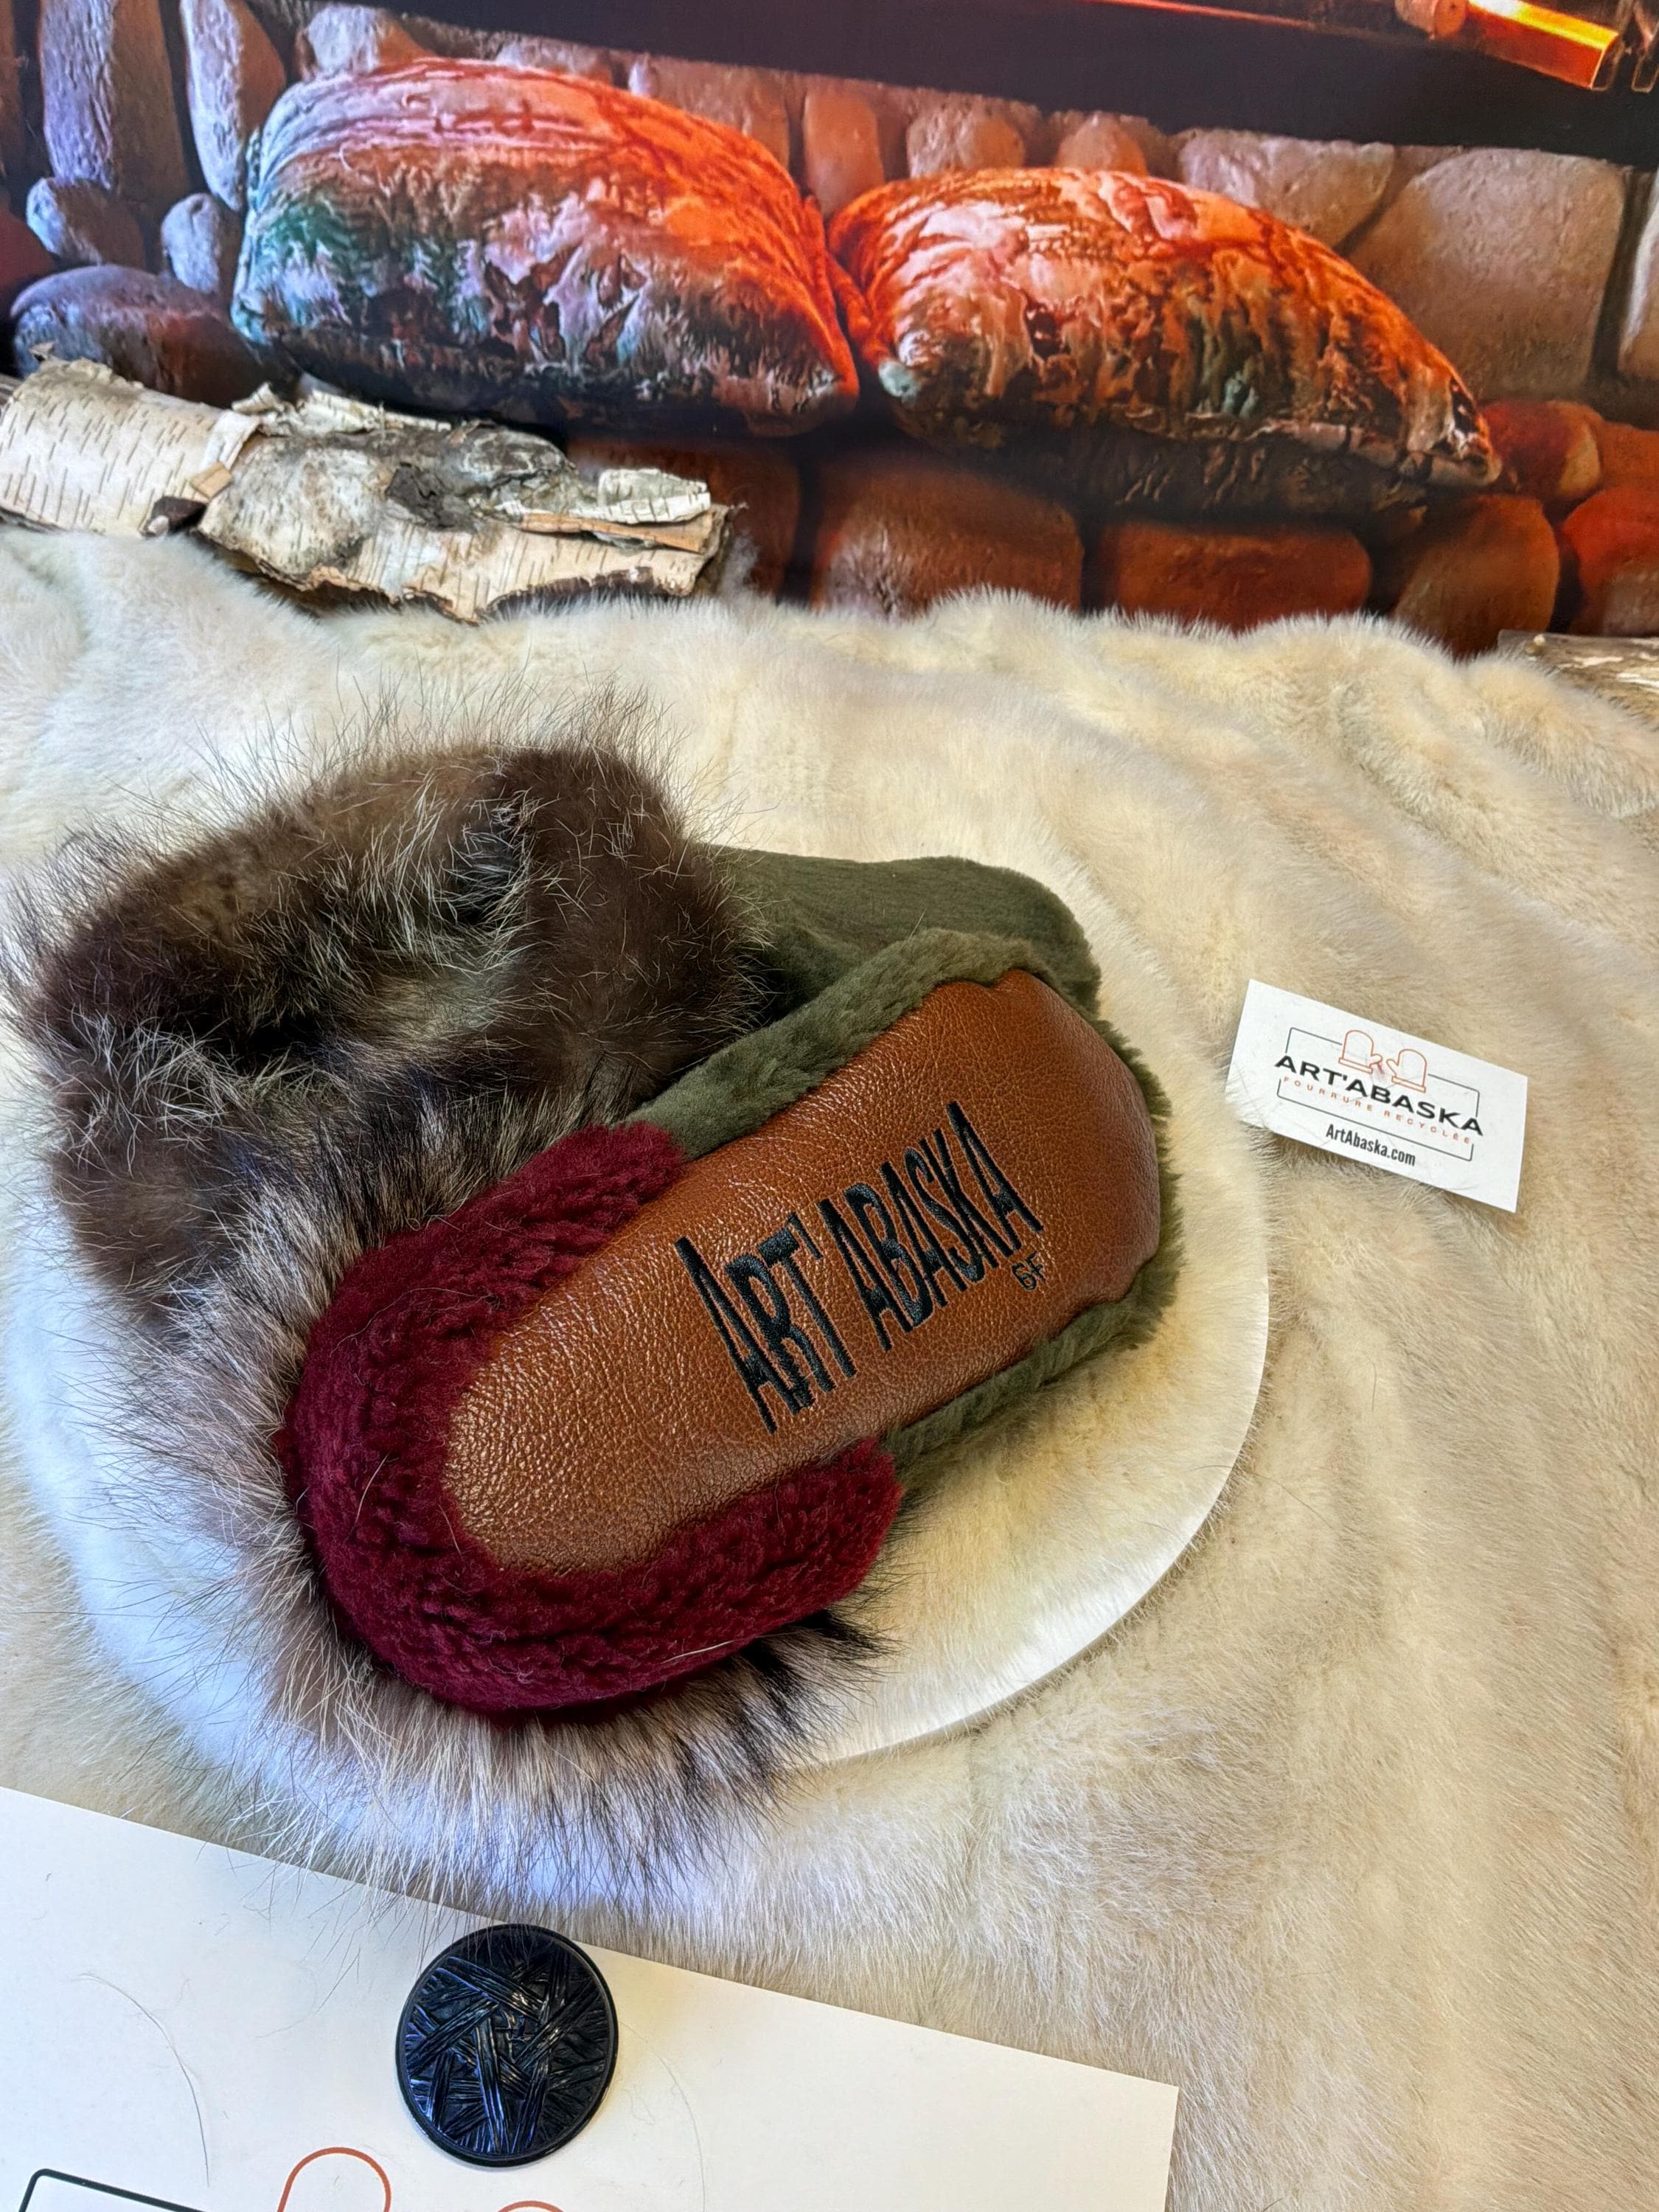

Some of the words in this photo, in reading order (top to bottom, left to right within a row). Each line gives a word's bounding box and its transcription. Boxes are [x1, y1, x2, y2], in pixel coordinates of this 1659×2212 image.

[1274, 1055, 1484, 1136] ART'ABASKA
[1284, 1077, 1372, 1110] FOURRURE
[1326, 1124, 1416, 1166] ArtAbaska.com
